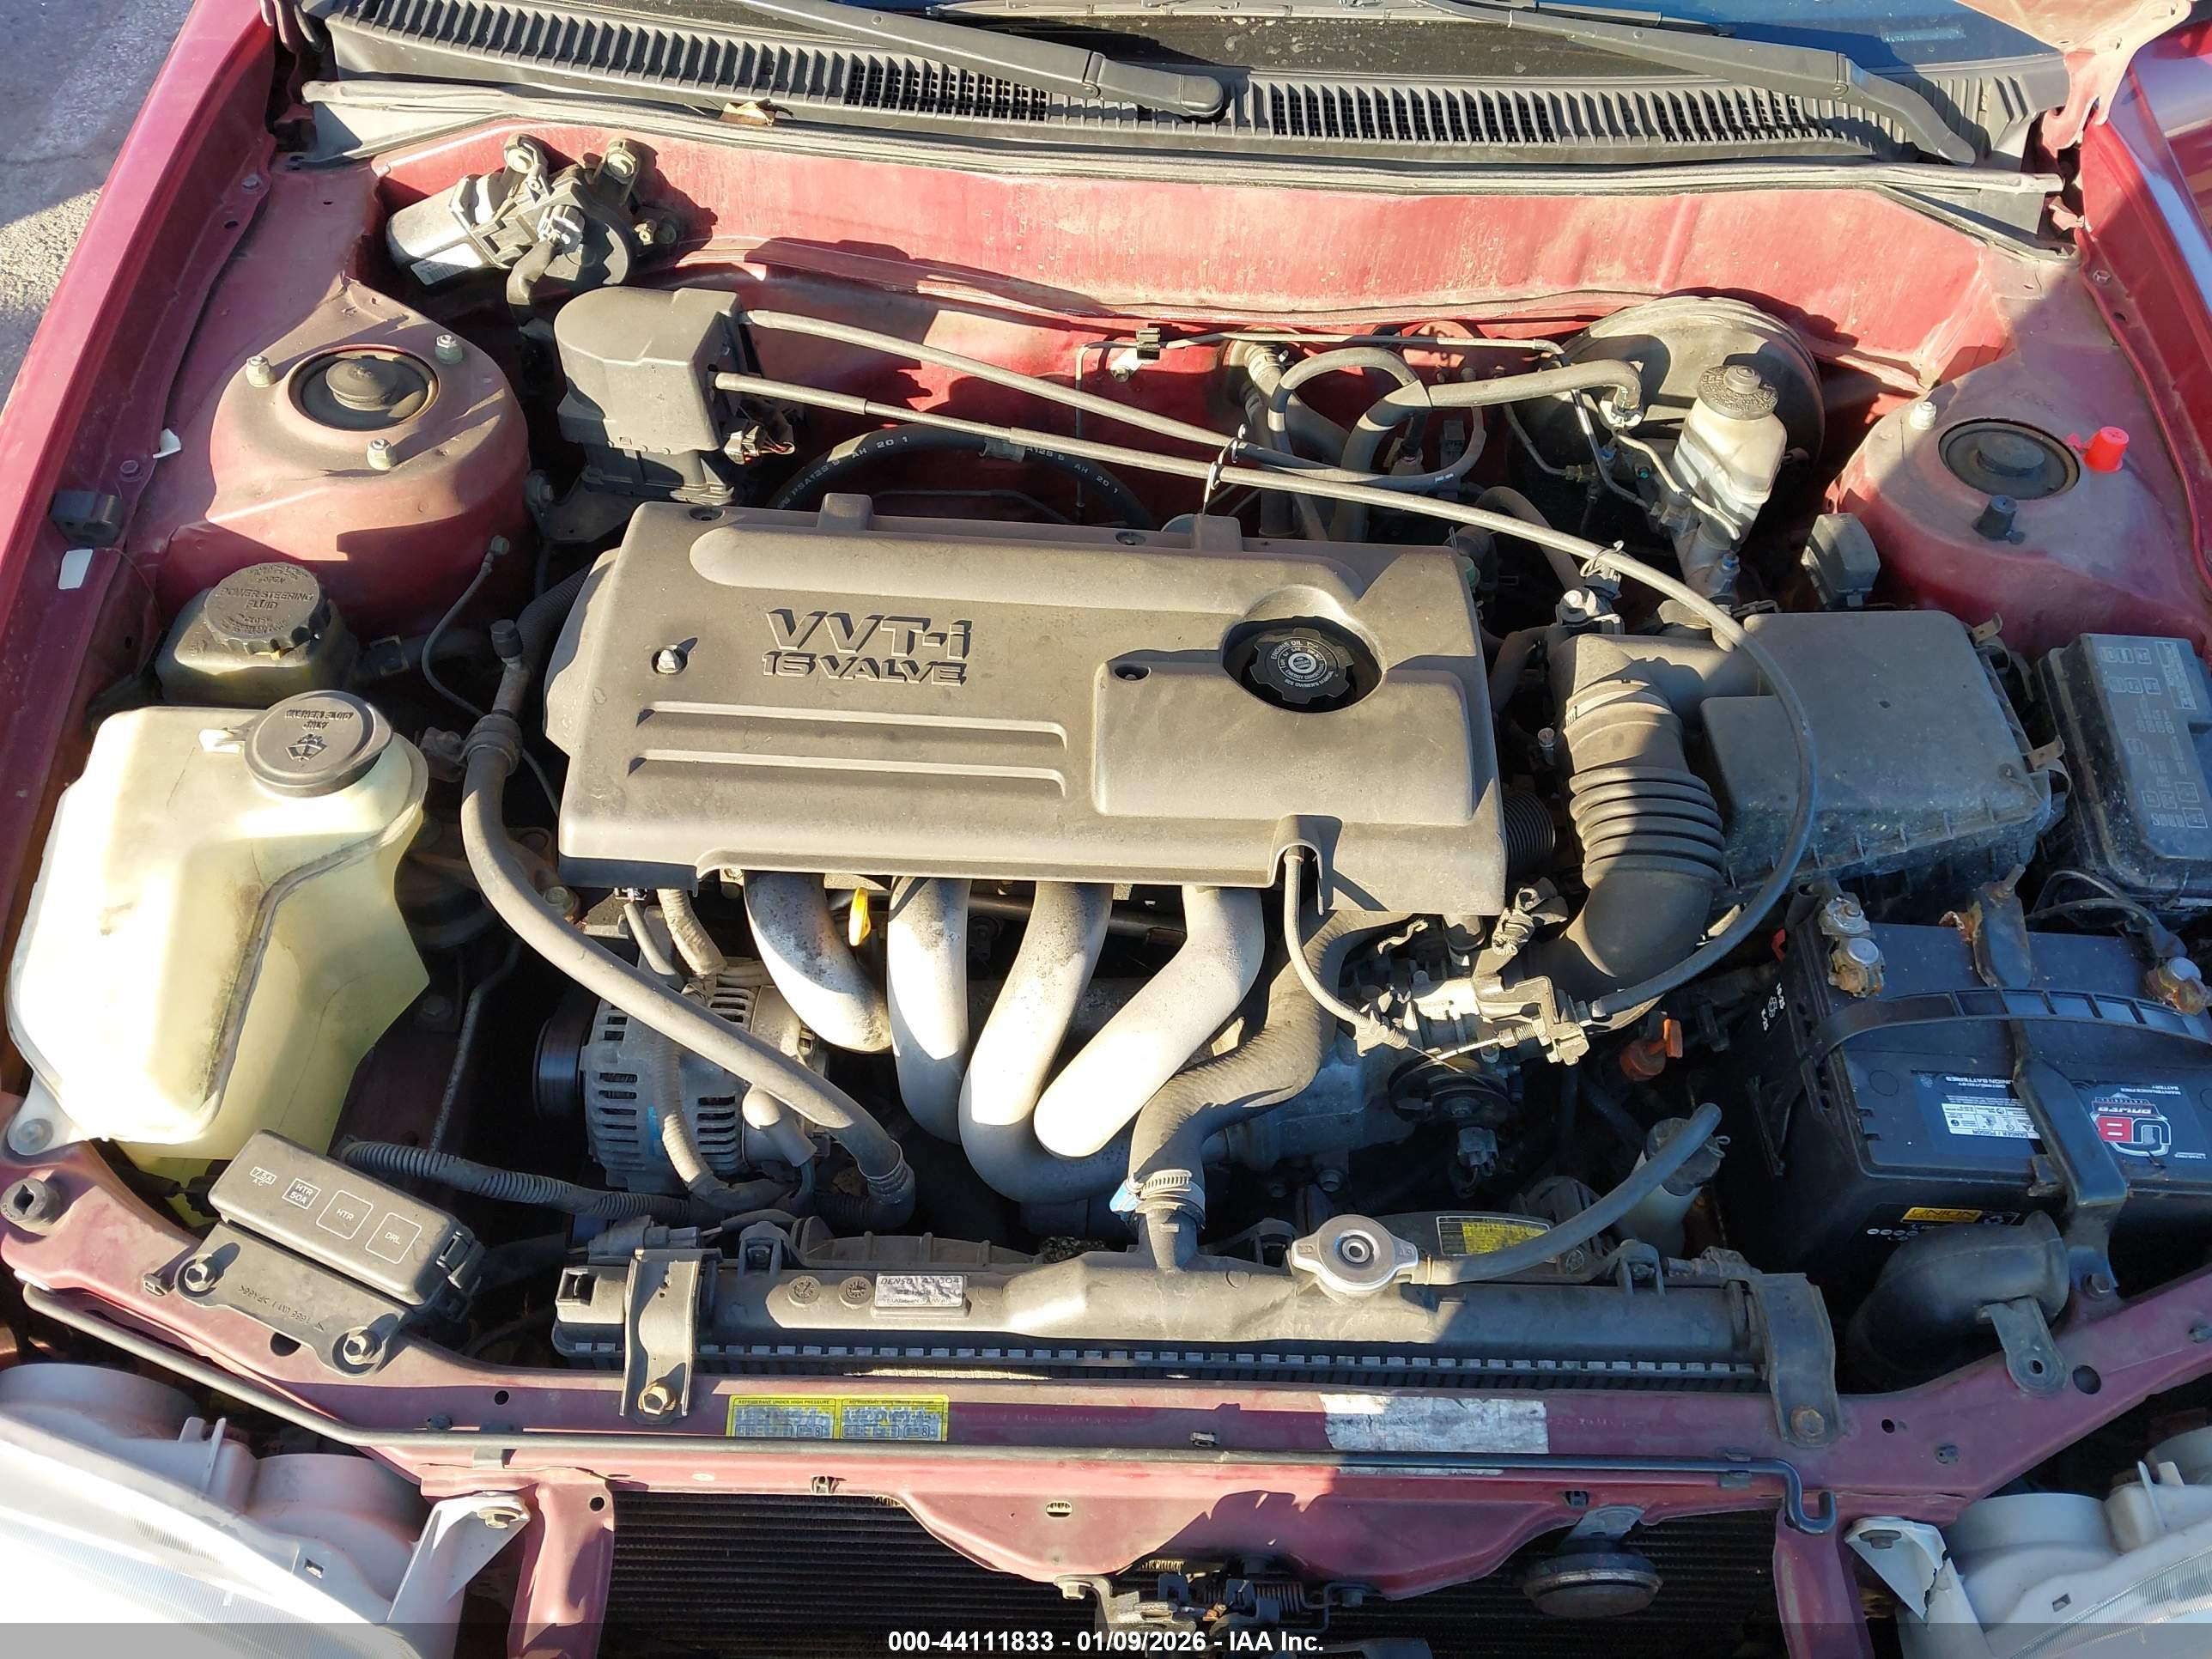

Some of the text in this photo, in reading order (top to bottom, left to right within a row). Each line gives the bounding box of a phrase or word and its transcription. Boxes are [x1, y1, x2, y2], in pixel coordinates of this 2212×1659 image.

[876, 439, 895, 449] 20
[260, 591, 313, 601] STEERING
[246, 599, 278, 609] FLUID
[766, 608, 972, 660] VVT-i
[1271, 641, 1290, 659] ENGINE
[762, 651, 968, 687] 16 VALVE
[325, 711, 354, 721] FLUID
[295, 1183, 313, 1196] HTR
[289, 1191, 307, 1205] 50A
[336, 1208, 355, 1222] HTR
[385, 1231, 401, 1245] DRL
[881, 1276, 913, 1285] DENSO
